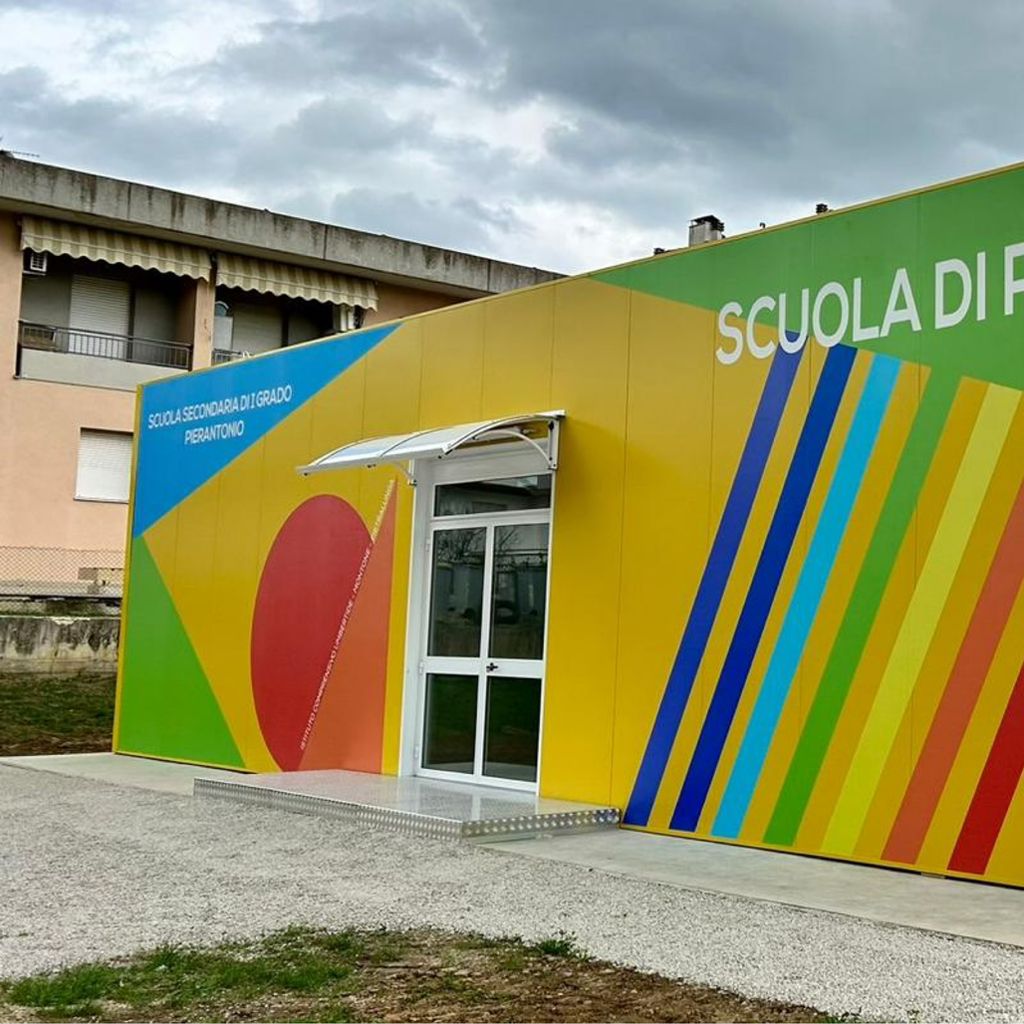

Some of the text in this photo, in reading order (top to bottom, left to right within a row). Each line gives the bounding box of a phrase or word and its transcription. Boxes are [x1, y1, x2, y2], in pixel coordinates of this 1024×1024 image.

[715, 267, 922, 366] SCUOLA
[934, 251, 987, 330] DI
[148, 408, 181, 429] SCUOLA
[182, 397, 239, 423] SECONDARIA
[240, 394, 250, 411] DI
[256, 384, 293, 408] GRADO
[184, 420, 245, 445] PIERANTONIO
